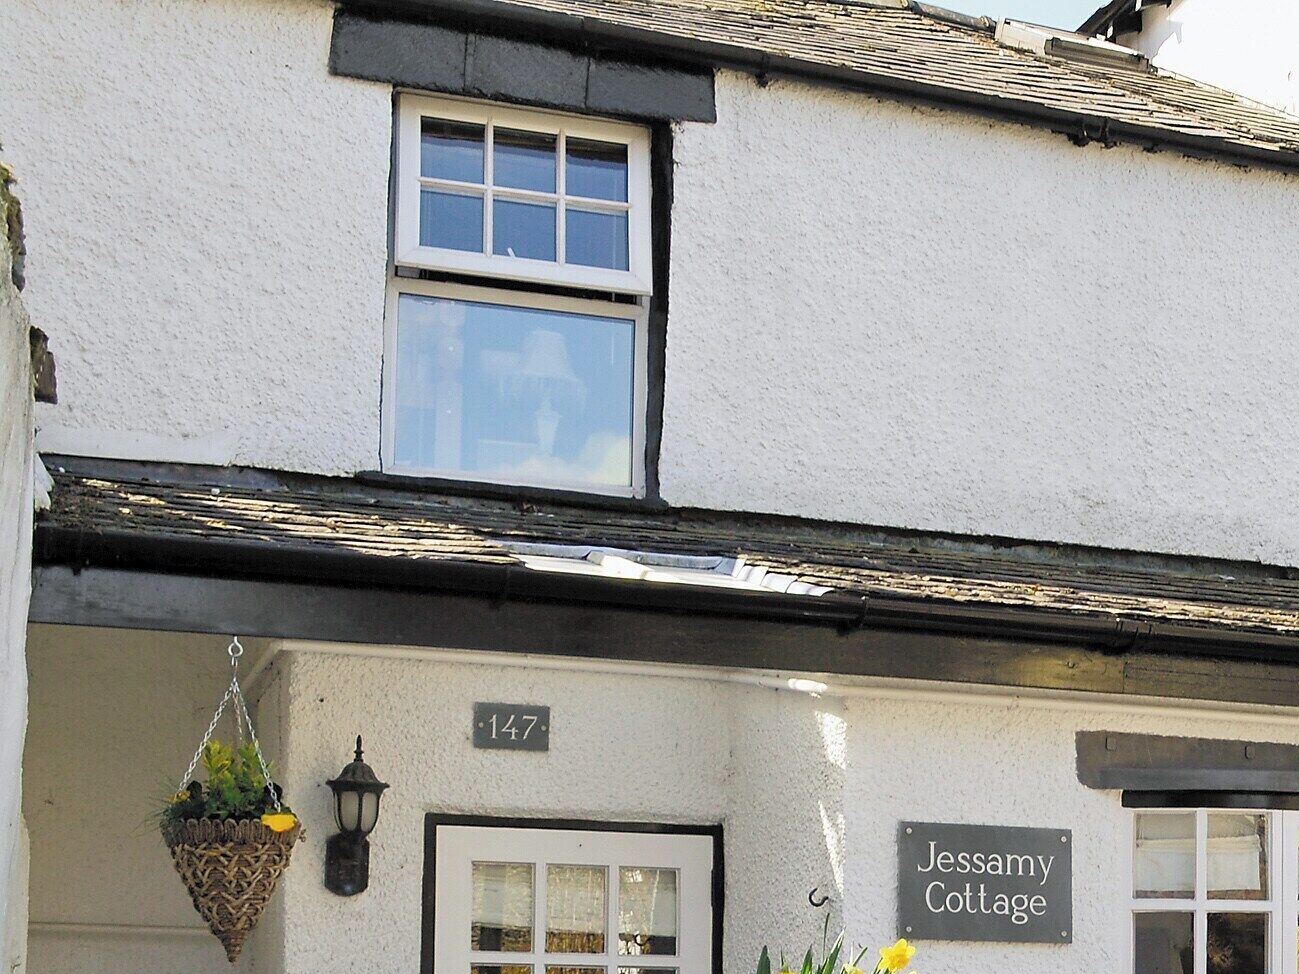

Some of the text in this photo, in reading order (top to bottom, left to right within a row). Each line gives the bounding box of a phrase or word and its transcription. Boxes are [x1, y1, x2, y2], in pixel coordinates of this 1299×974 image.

[488, 713, 538, 740] 147
[917, 840, 1055, 886] Jessamy
[925, 881, 1047, 925] Cottage
